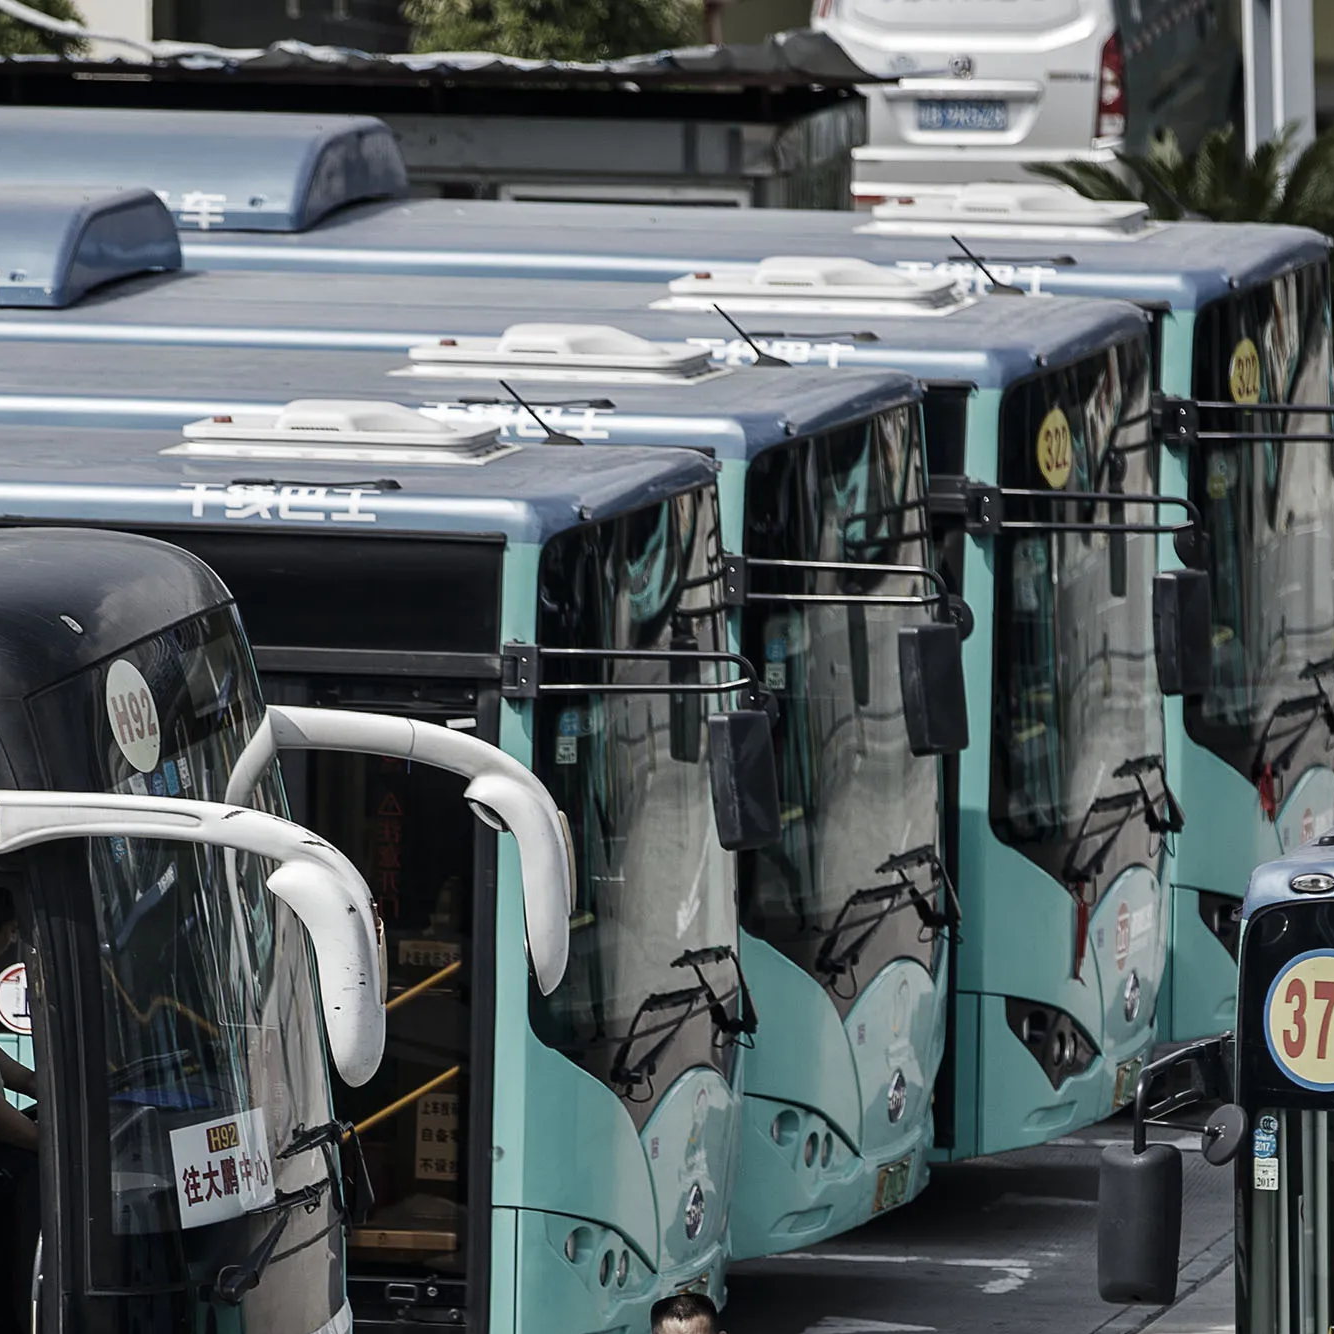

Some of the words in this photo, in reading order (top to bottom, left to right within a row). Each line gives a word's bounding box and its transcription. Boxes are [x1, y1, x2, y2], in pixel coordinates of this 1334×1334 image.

[1045, 427, 1068, 471] 322
[111, 687, 158, 745] H92
[209, 1124, 239, 1151] H92
[182, 1149, 269, 1207] 往大鹏中心
[1257, 1176, 1275, 1189] 2017
